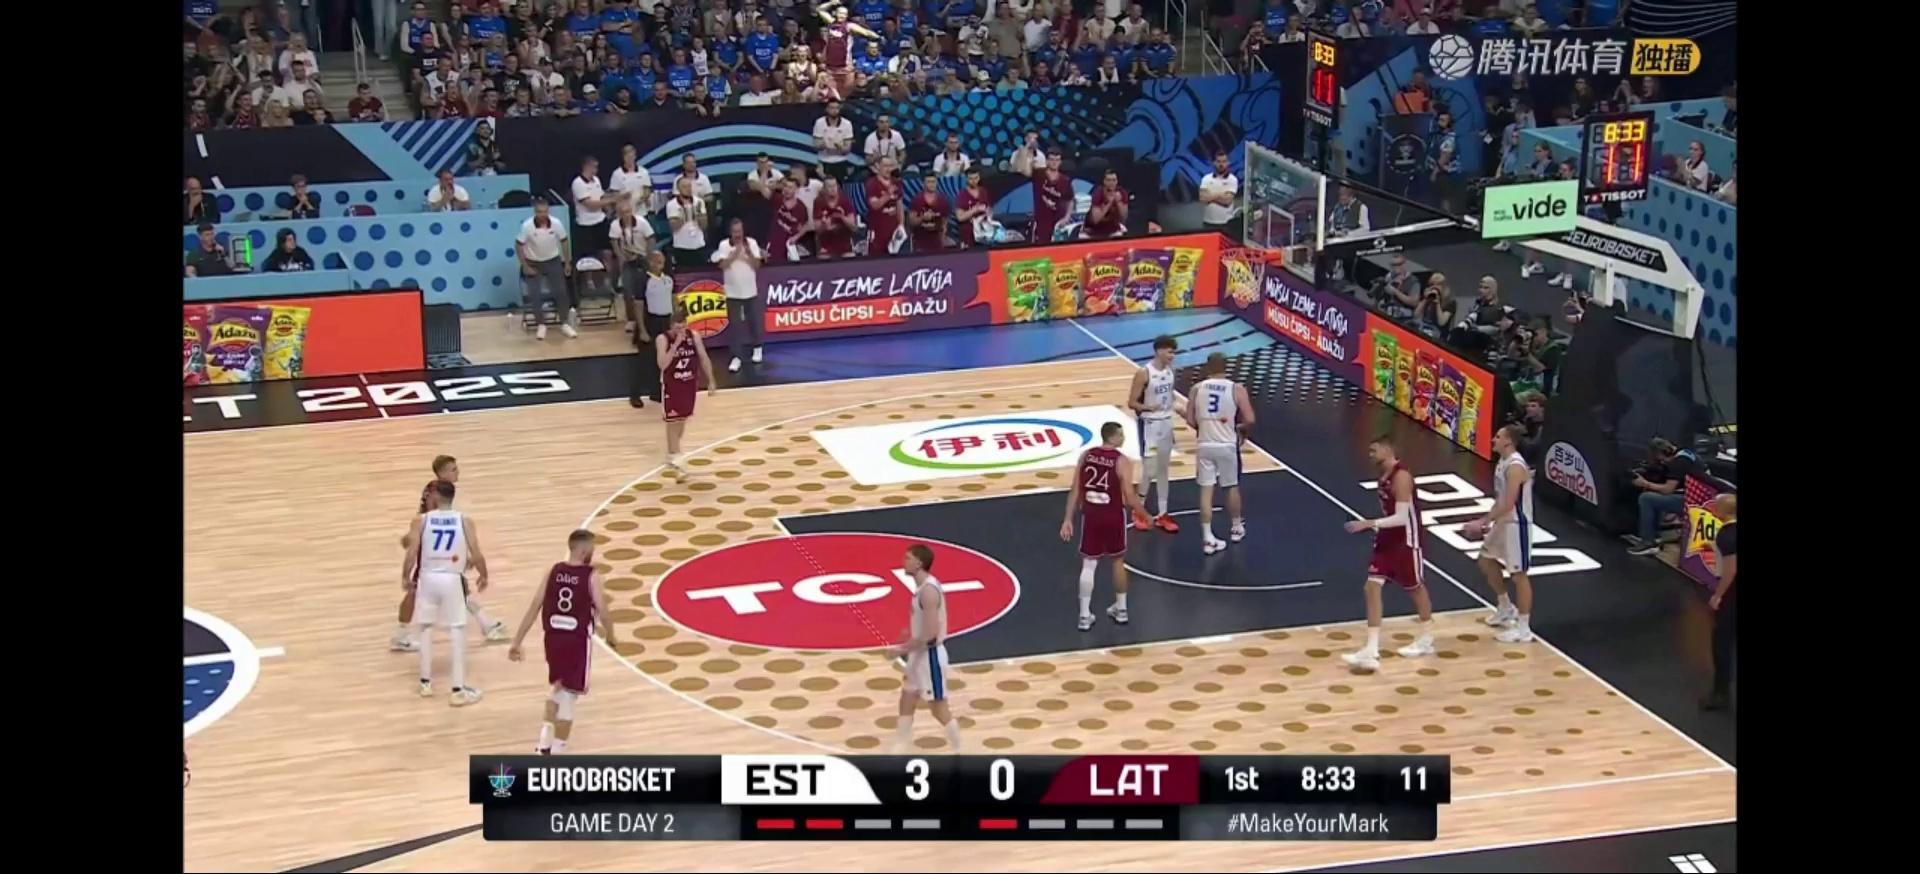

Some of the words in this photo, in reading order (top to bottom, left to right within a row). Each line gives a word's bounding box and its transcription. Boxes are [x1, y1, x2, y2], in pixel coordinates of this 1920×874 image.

[1604, 120, 1645, 144] 8:33
[1606, 144, 1642, 184] 11
[1601, 189, 1646, 201] TISSOT
[767, 280, 823, 304] MŪSU
[831, 276, 884, 300] ZEME
[775, 309, 826, 327] MŪSU
[829, 304, 873, 323] ČIPSI
[889, 297, 947, 318] ĀDAŽU
[297, 370, 571, 413] 2025
[1208, 394, 1219, 413] 3
[918, 428, 1061, 458] 伊利
[1084, 466, 1109, 490] 24
[432, 529, 456, 551] 77
[557, 586, 573, 612] 8
[685, 568, 985, 616] TCL
